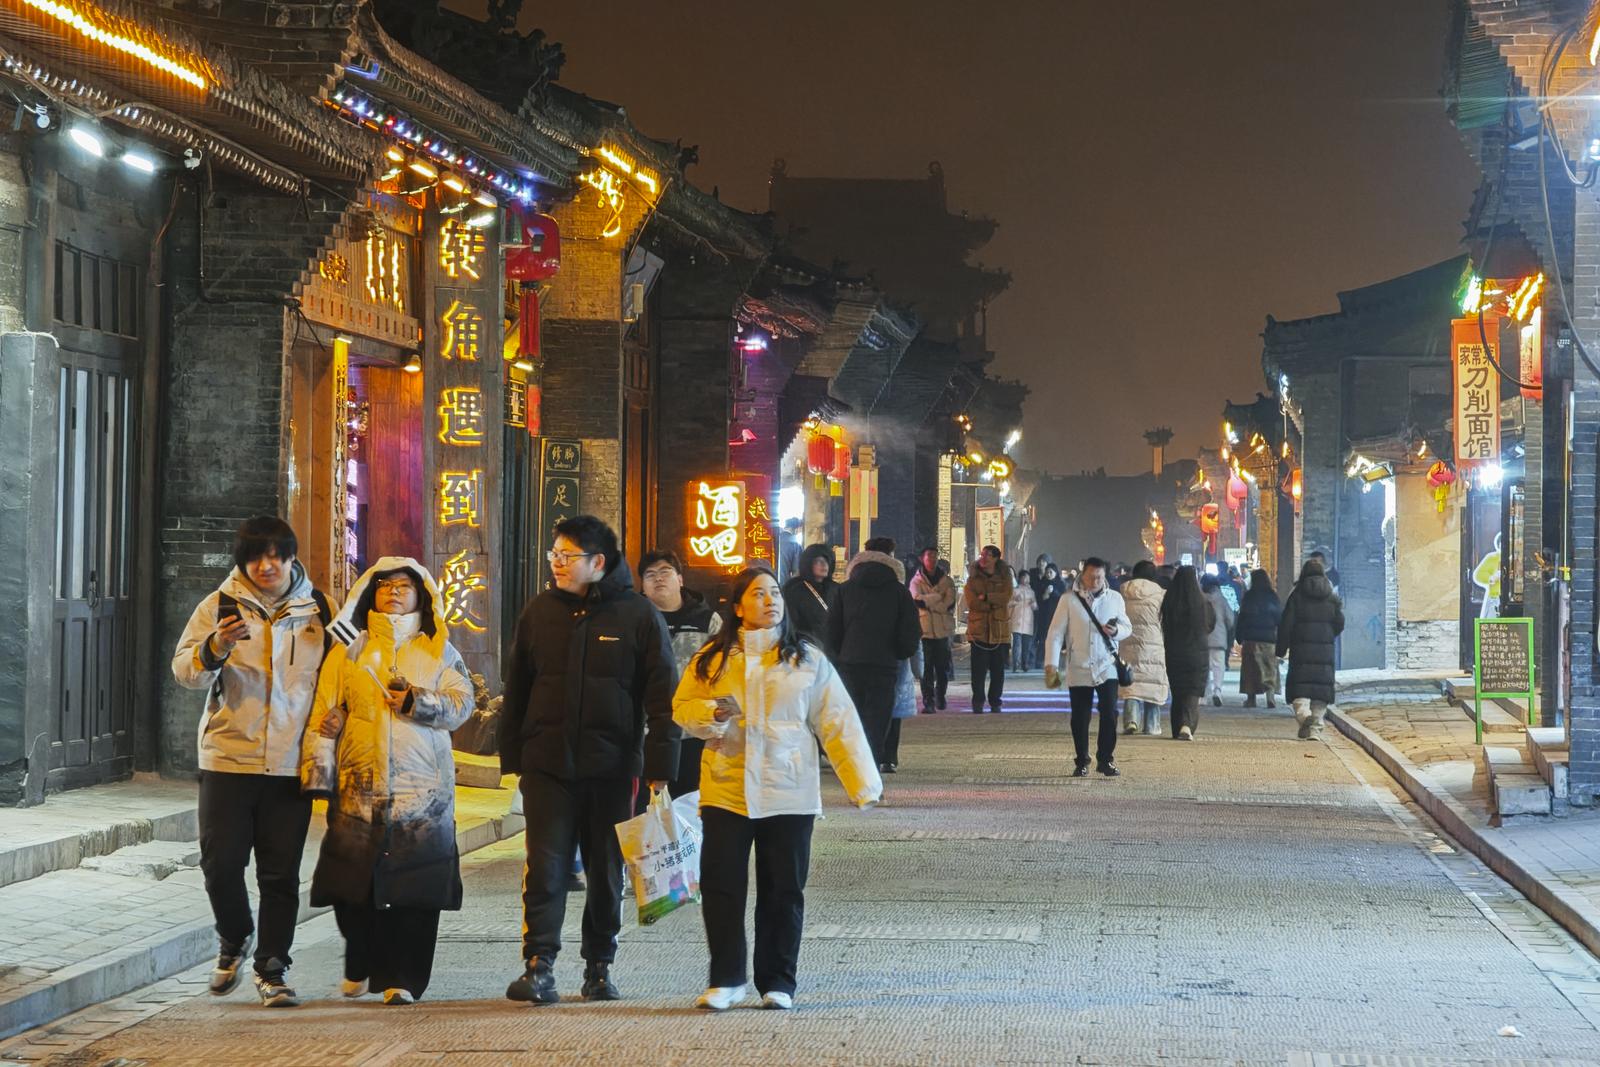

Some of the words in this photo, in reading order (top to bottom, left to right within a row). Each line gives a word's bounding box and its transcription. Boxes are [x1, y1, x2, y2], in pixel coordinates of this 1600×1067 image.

[1462, 366, 1493, 459] 刀削面馆
[690, 482, 743, 565] 酒吧
